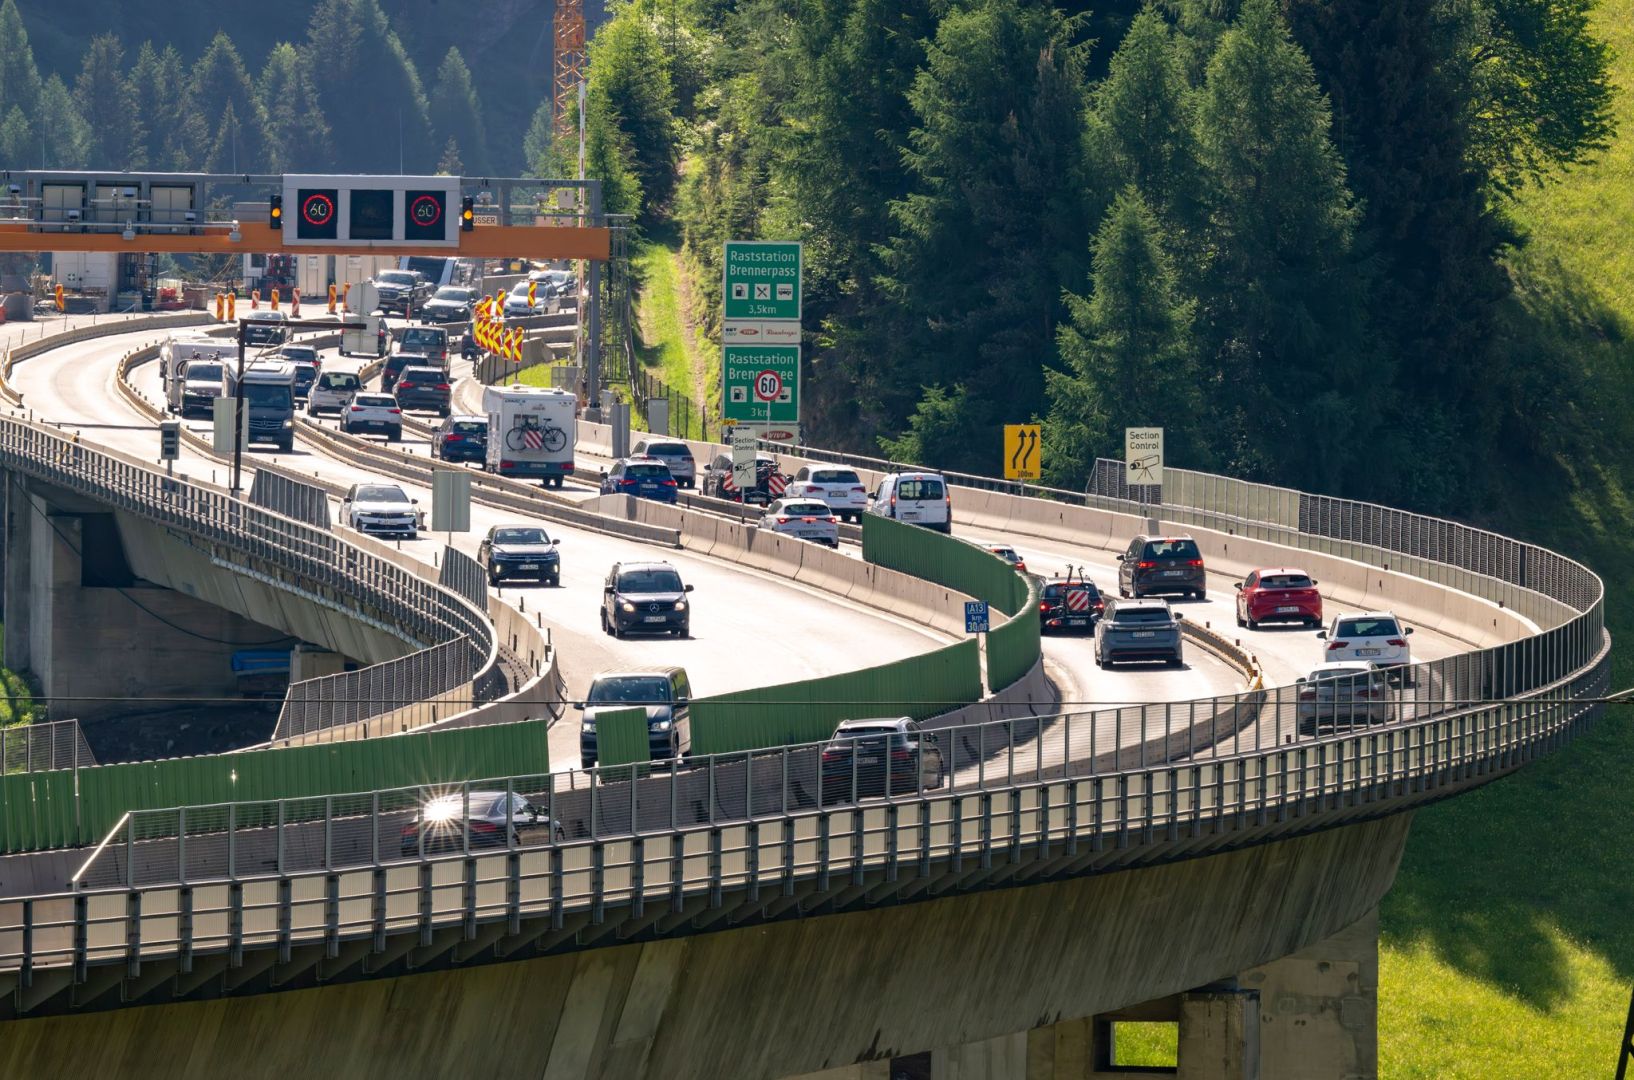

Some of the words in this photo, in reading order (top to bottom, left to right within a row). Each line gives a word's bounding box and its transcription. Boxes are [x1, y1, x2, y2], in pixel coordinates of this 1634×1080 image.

[310, 203, 327, 216] 60
[417, 204, 434, 217] 60
[473, 216, 496, 225] USSER
[731, 250, 796, 262] Raststation
[730, 264, 796, 278] Brennerpass
[748, 304, 777, 315] 3,5km
[729, 353, 794, 365] Raststation
[729, 367, 794, 381] Brenee
[761, 377, 776, 394] 60
[769, 431, 787, 440] VIVA
[1129, 431, 1160, 440] Section
[1129, 441, 1159, 450] Control
[969, 603, 984, 614] A13
